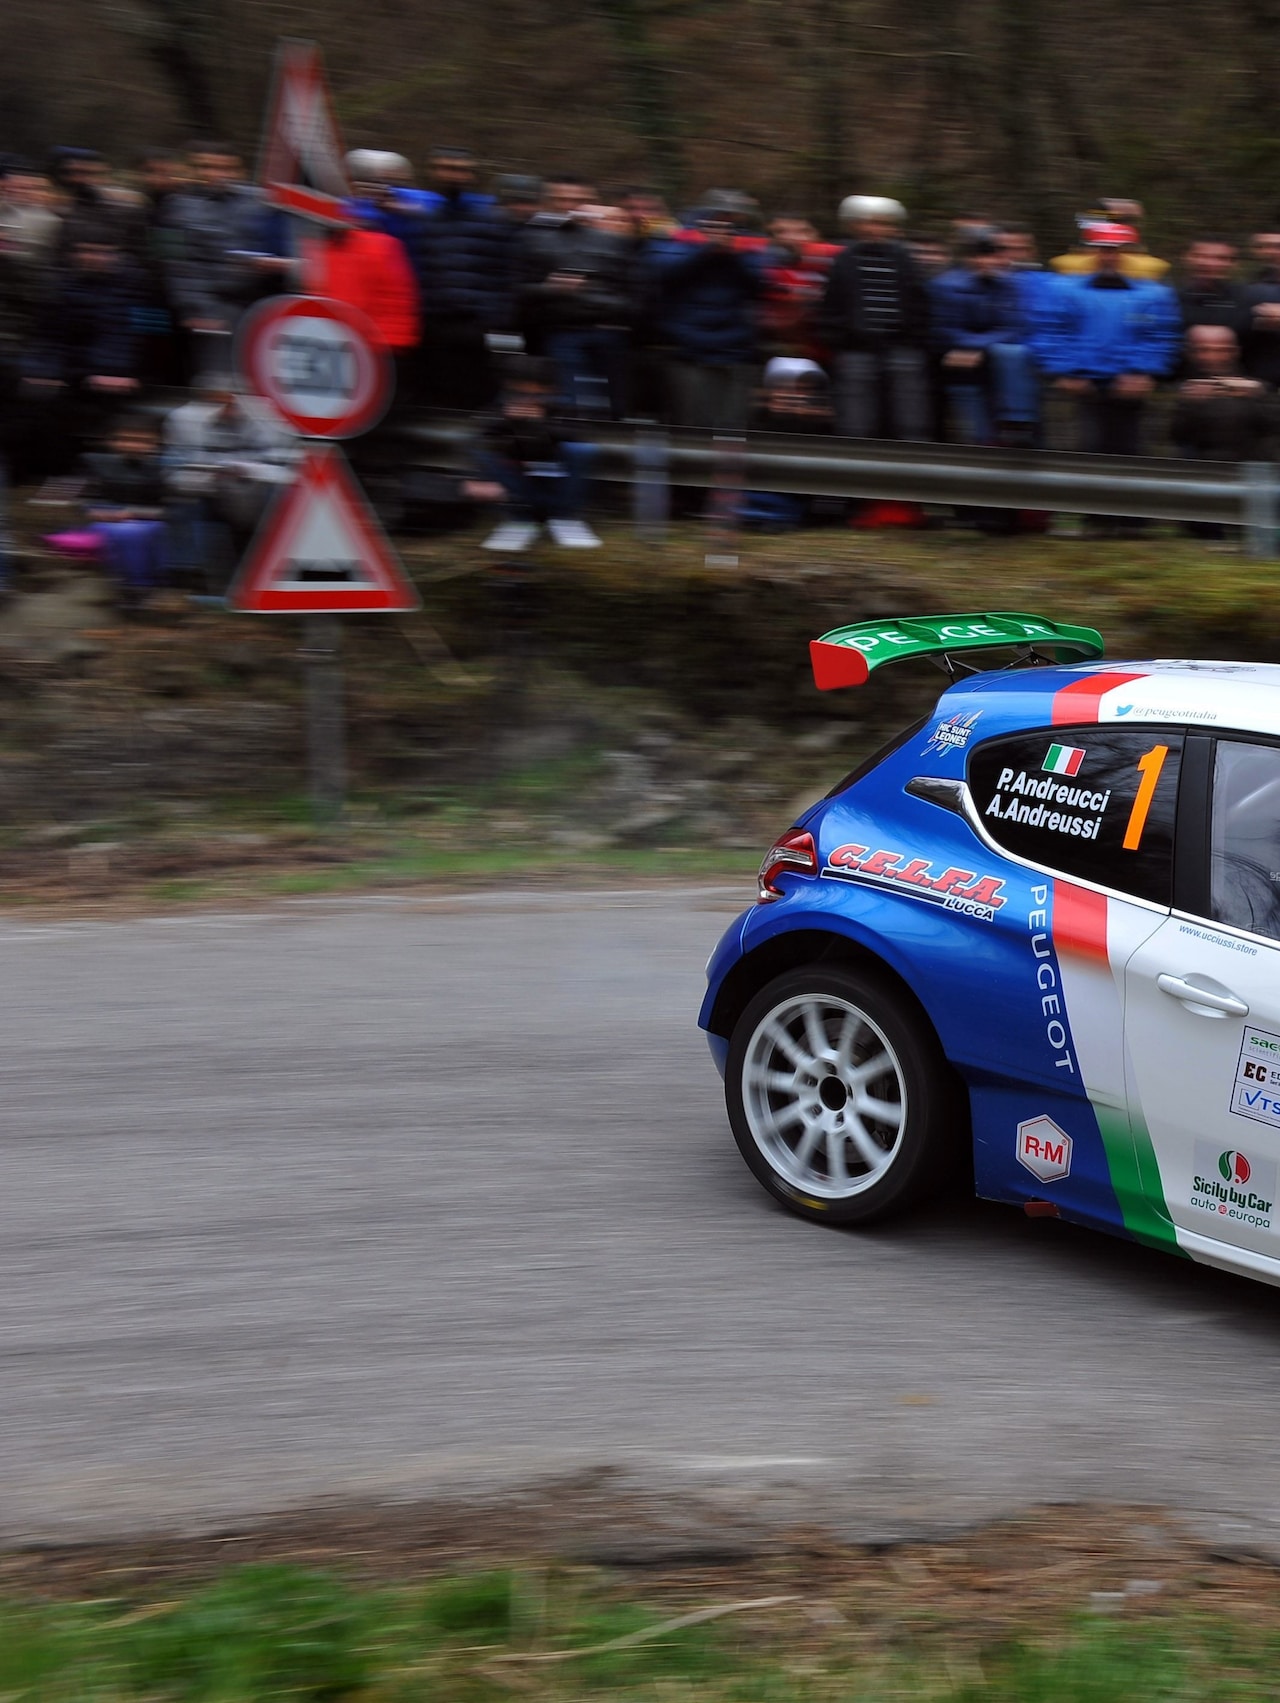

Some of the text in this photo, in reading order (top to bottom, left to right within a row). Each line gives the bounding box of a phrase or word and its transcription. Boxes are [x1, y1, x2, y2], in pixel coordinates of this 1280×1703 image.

[1132, 705, 1218, 720] @peugeotitalia
[935, 731, 967, 746] LEONES
[939, 723, 972, 737] HIC SUNT
[996, 768, 1112, 813] P.Andreucci
[1122, 744, 1169, 851] 1
[985, 794, 1103, 840] A.Andreussi
[828, 844, 1005, 908] C.E.L.F.A.
[945, 900, 993, 921] LUCCA
[1178, 923, 1259, 957] www.ucciussi.store
[1028, 883, 1075, 1074] PEUGEOT
[1243, 1061, 1267, 1083] EC
[1024, 1134, 1065, 1166] R-M
[1190, 1196, 1217, 1212] auto
